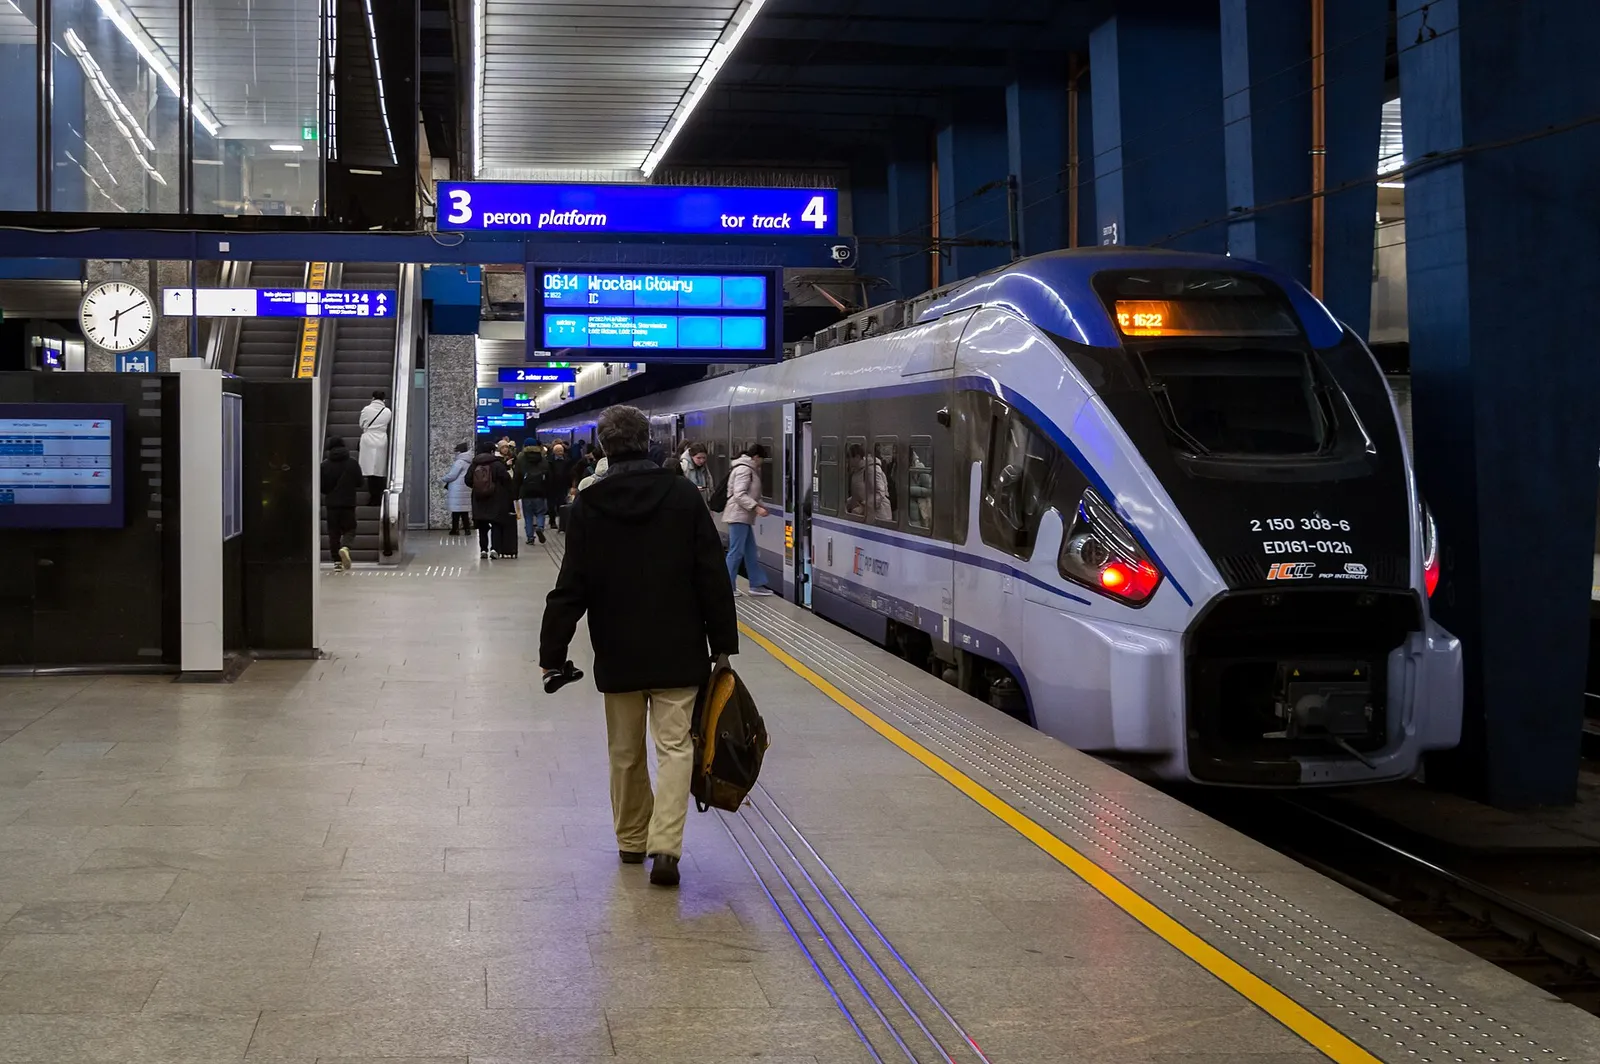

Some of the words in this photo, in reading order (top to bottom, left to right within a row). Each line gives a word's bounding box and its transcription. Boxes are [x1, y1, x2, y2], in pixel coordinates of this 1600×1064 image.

[448, 189, 473, 224] 3
[483, 212, 531, 228] peron
[538, 209, 607, 228] platform
[721, 214, 745, 228] tor
[752, 213, 791, 229] track
[801, 196, 827, 229] 4
[543, 275, 578, 290] 06:14
[588, 276, 642, 291] Wrocław
[645, 276, 693, 293] Główny
[344, 293, 350, 303] 1
[351, 293, 360, 303] 2
[360, 293, 369, 303] 4
[588, 293, 598, 304] IC
[1133, 314, 1162, 327] 1622
[516, 370, 525, 380] 2
[1250, 520, 1262, 532] 2
[1266, 518, 1295, 531] 150
[1300, 518, 1351, 532] 308-6
[1263, 540, 1352, 554] ED161-012h
